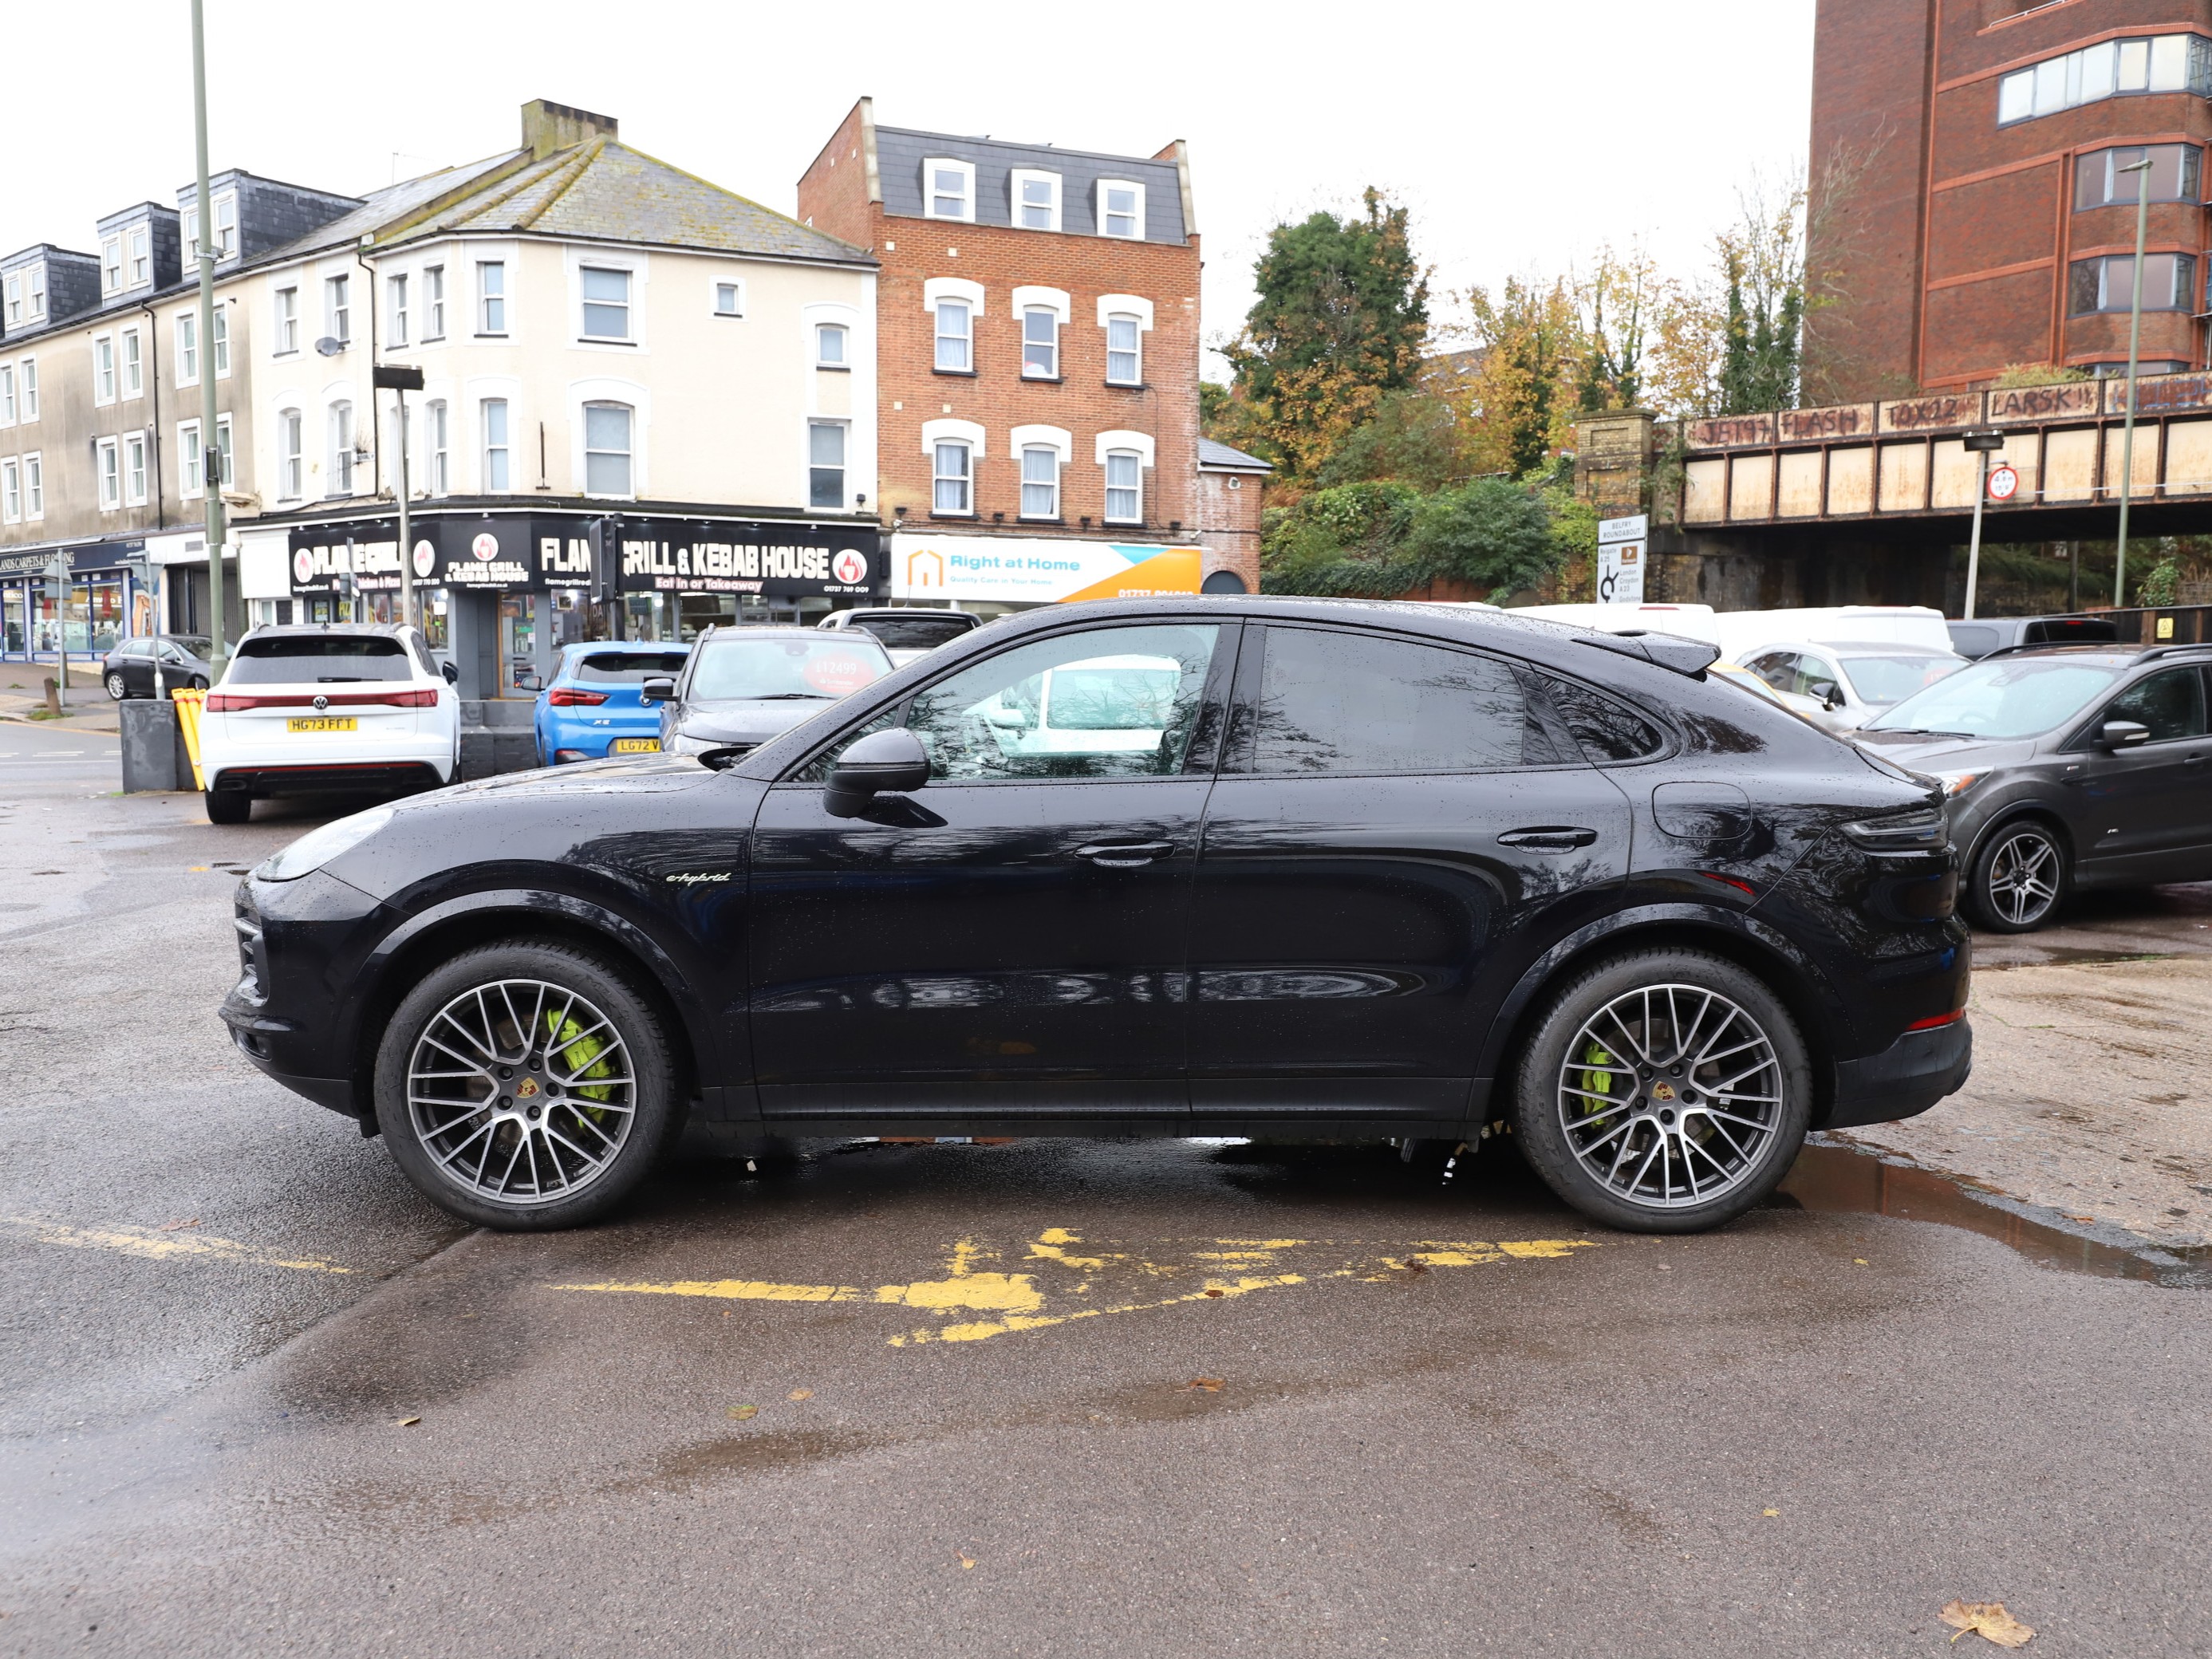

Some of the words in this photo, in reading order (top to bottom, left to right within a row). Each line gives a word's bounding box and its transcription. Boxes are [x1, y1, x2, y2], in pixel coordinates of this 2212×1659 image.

[1886, 399, 1958, 426] TOX22
[1780, 408, 1859, 436] FLASH
[1611, 521, 1631, 530] BELFRY
[1603, 527, 1640, 538] ROUNDABOUT
[0, 558, 15, 570] ANDS
[15, 555, 38, 568] CARPETS
[541, 537, 591, 573] FLAM
[676, 548, 691, 575] &
[692, 543, 759, 577] KEBAB
[761, 546, 830, 580] HOUSE
[950, 555, 1001, 570] Right
[1005, 558, 1023, 569] at
[1027, 558, 1081, 571] Home
[448, 562, 488, 573] FLAME
[488, 562, 525, 573] GRILL
[453, 571, 489, 582] KEBAB
[490, 571, 529, 582] HOUSE
[949, 575, 978, 584] Quality
[655, 577, 674, 589] Eat
[689, 579, 703, 589] or
[704, 577, 763, 593] Takeaway
[292, 719, 325, 730] HG73
[621, 741, 649, 751] LG72
